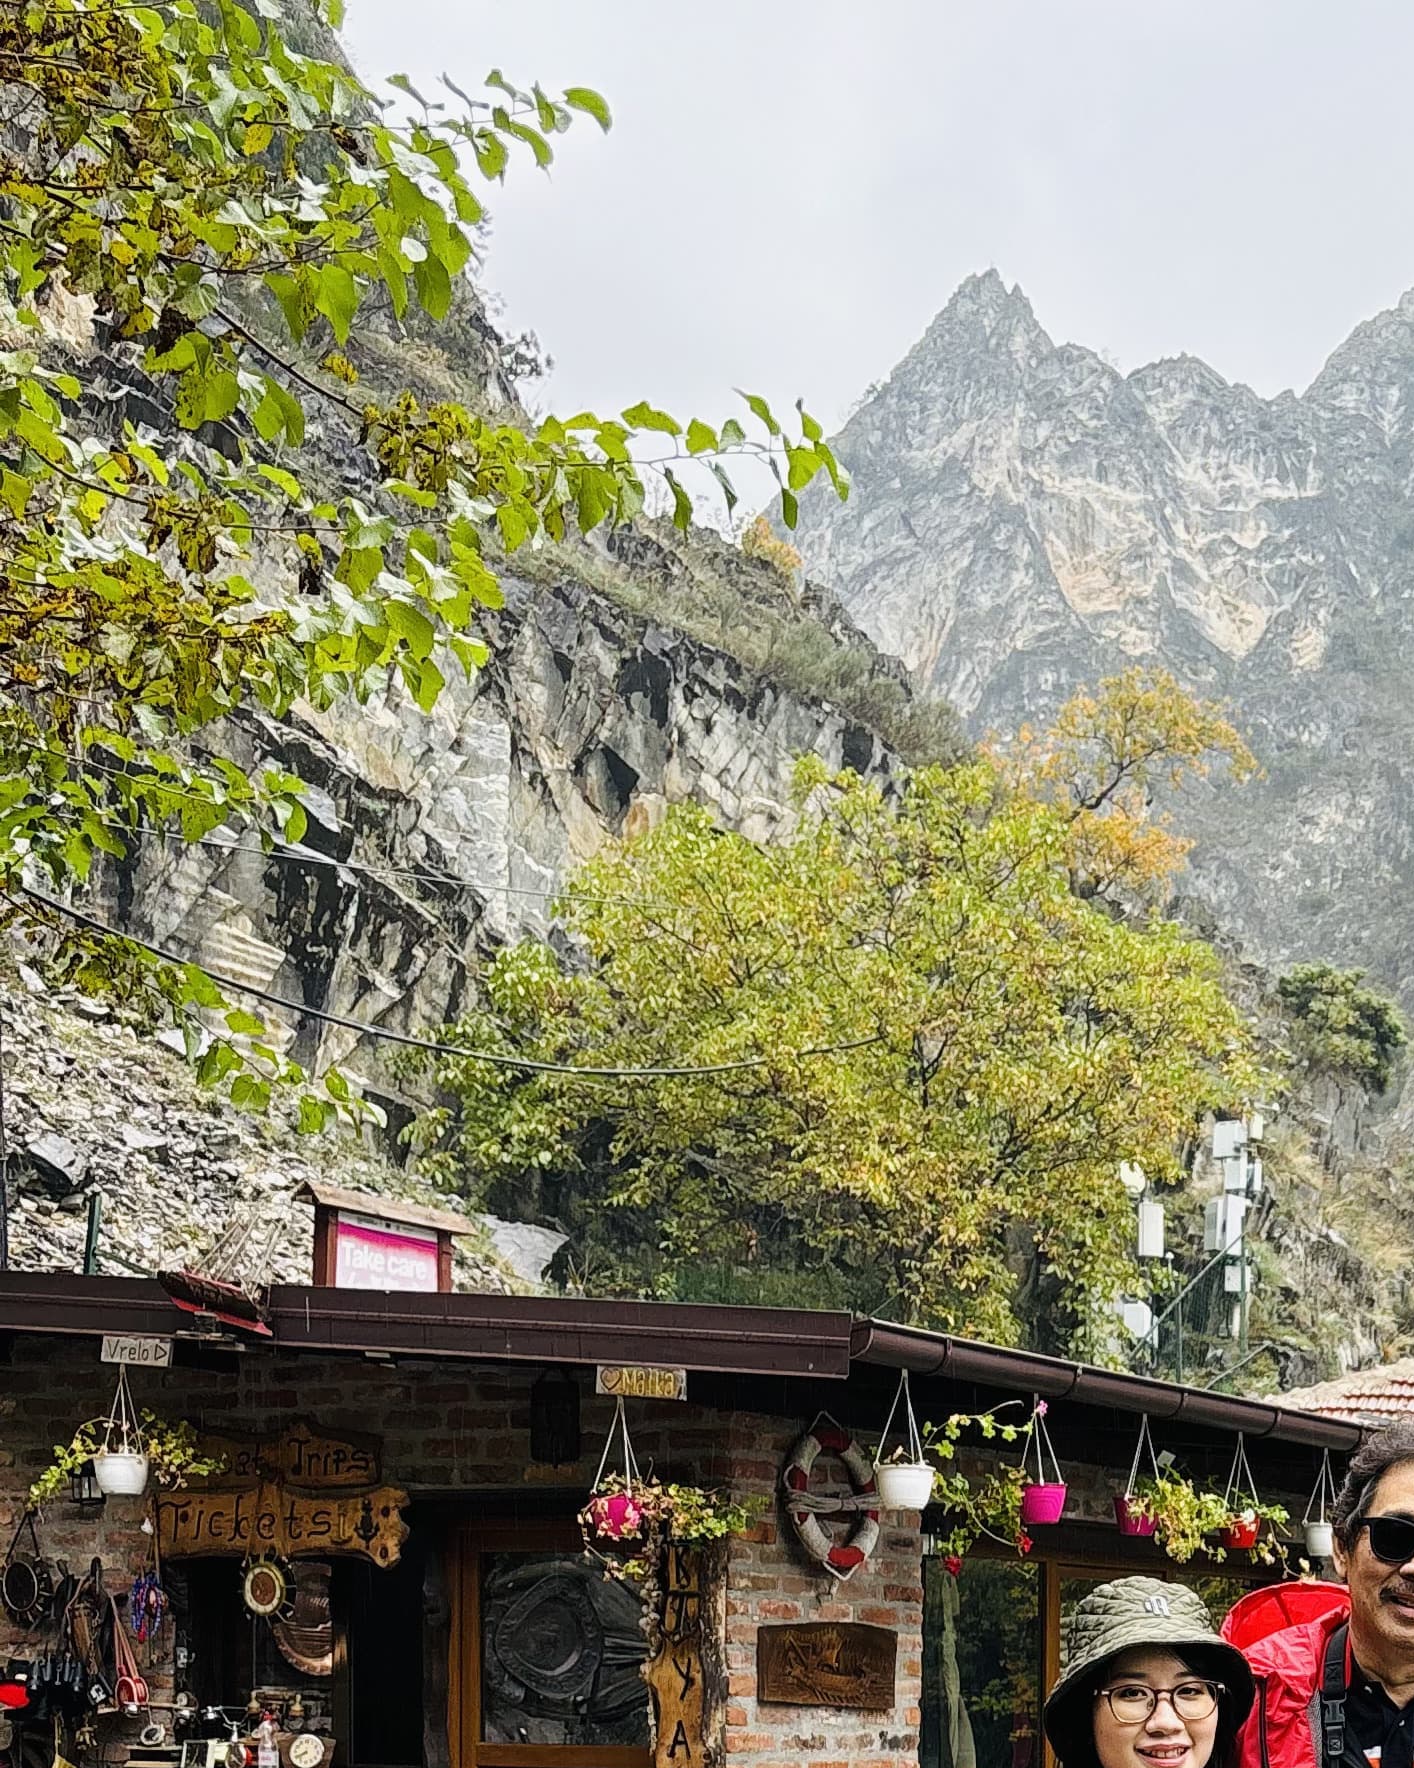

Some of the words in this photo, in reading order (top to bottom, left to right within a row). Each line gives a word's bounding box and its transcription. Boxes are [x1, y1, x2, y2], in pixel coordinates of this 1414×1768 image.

[341, 1238, 384, 1274] Take
[387, 1254, 427, 1281] care
[106, 1338, 149, 1361] Vrelo
[288, 1437, 371, 1477] Trips
[158, 1494, 333, 1543] Tickets
